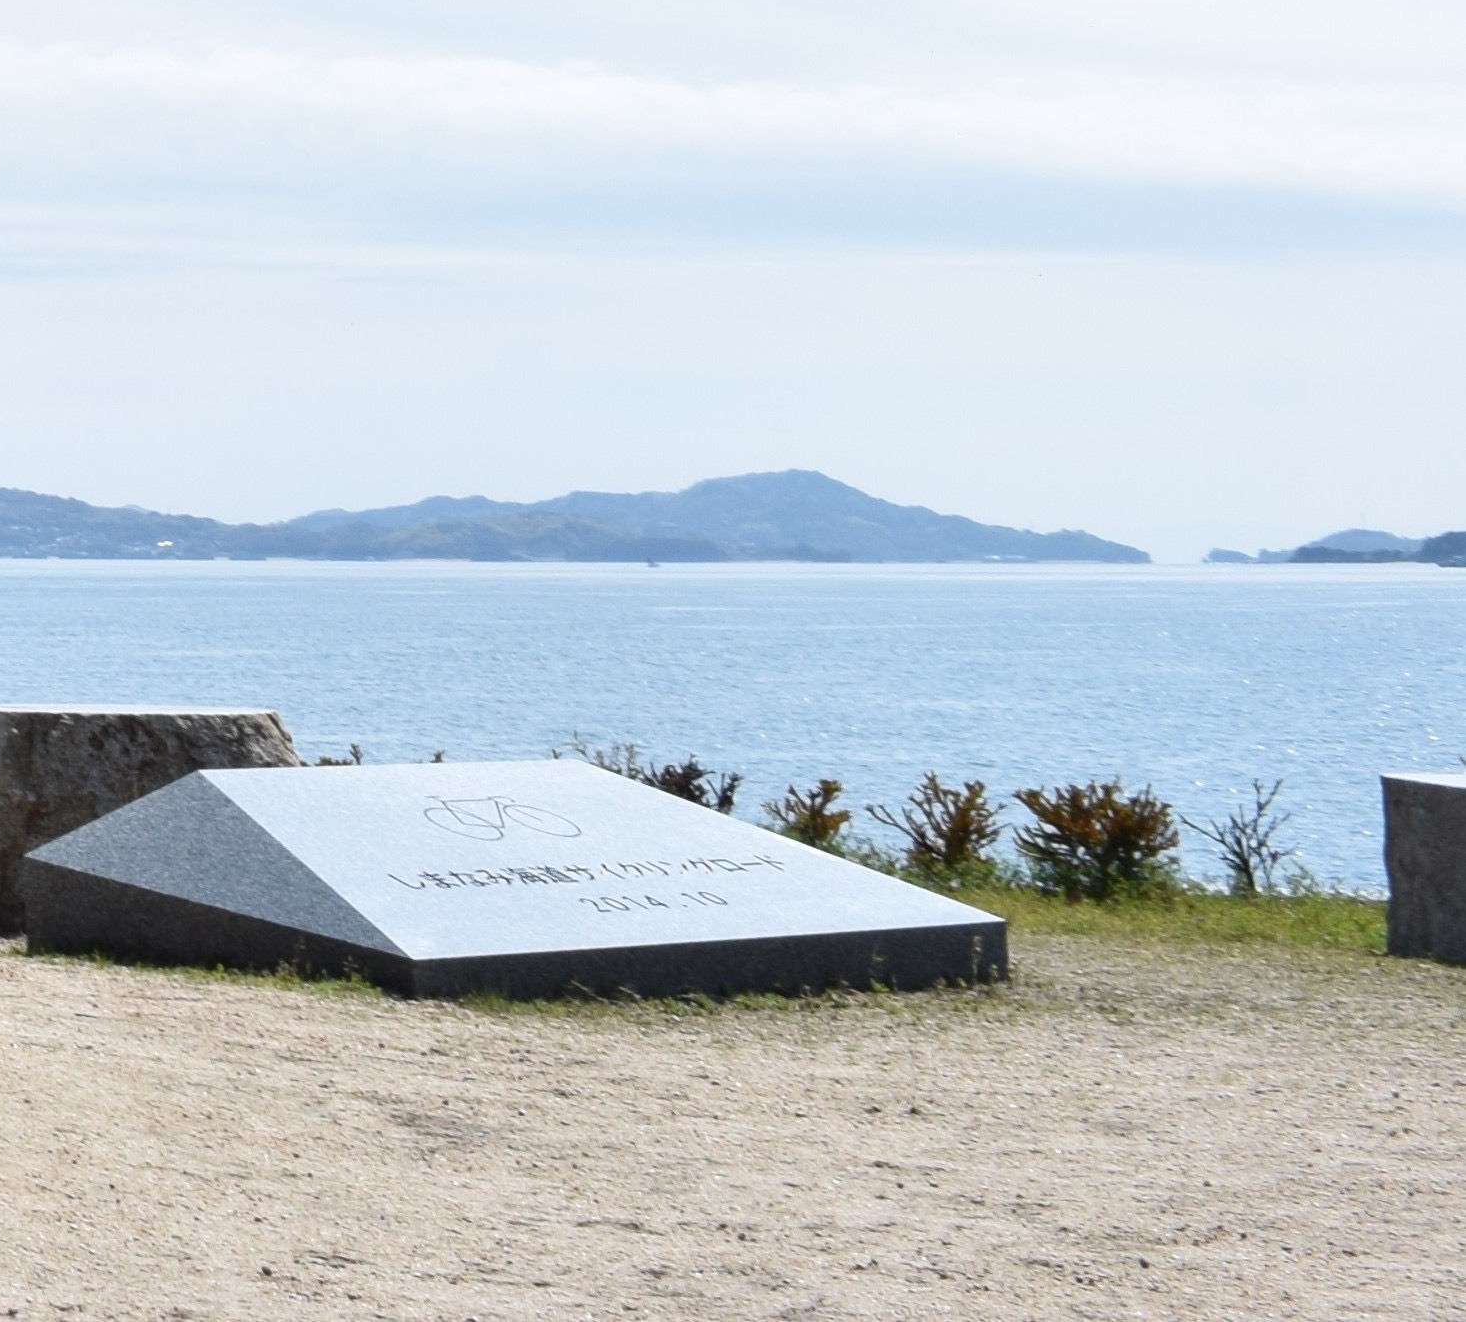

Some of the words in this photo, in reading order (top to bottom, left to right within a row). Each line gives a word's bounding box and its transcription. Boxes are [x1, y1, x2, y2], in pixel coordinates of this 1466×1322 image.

[387, 854, 785, 890] しまなみ海道サイクリングロード
